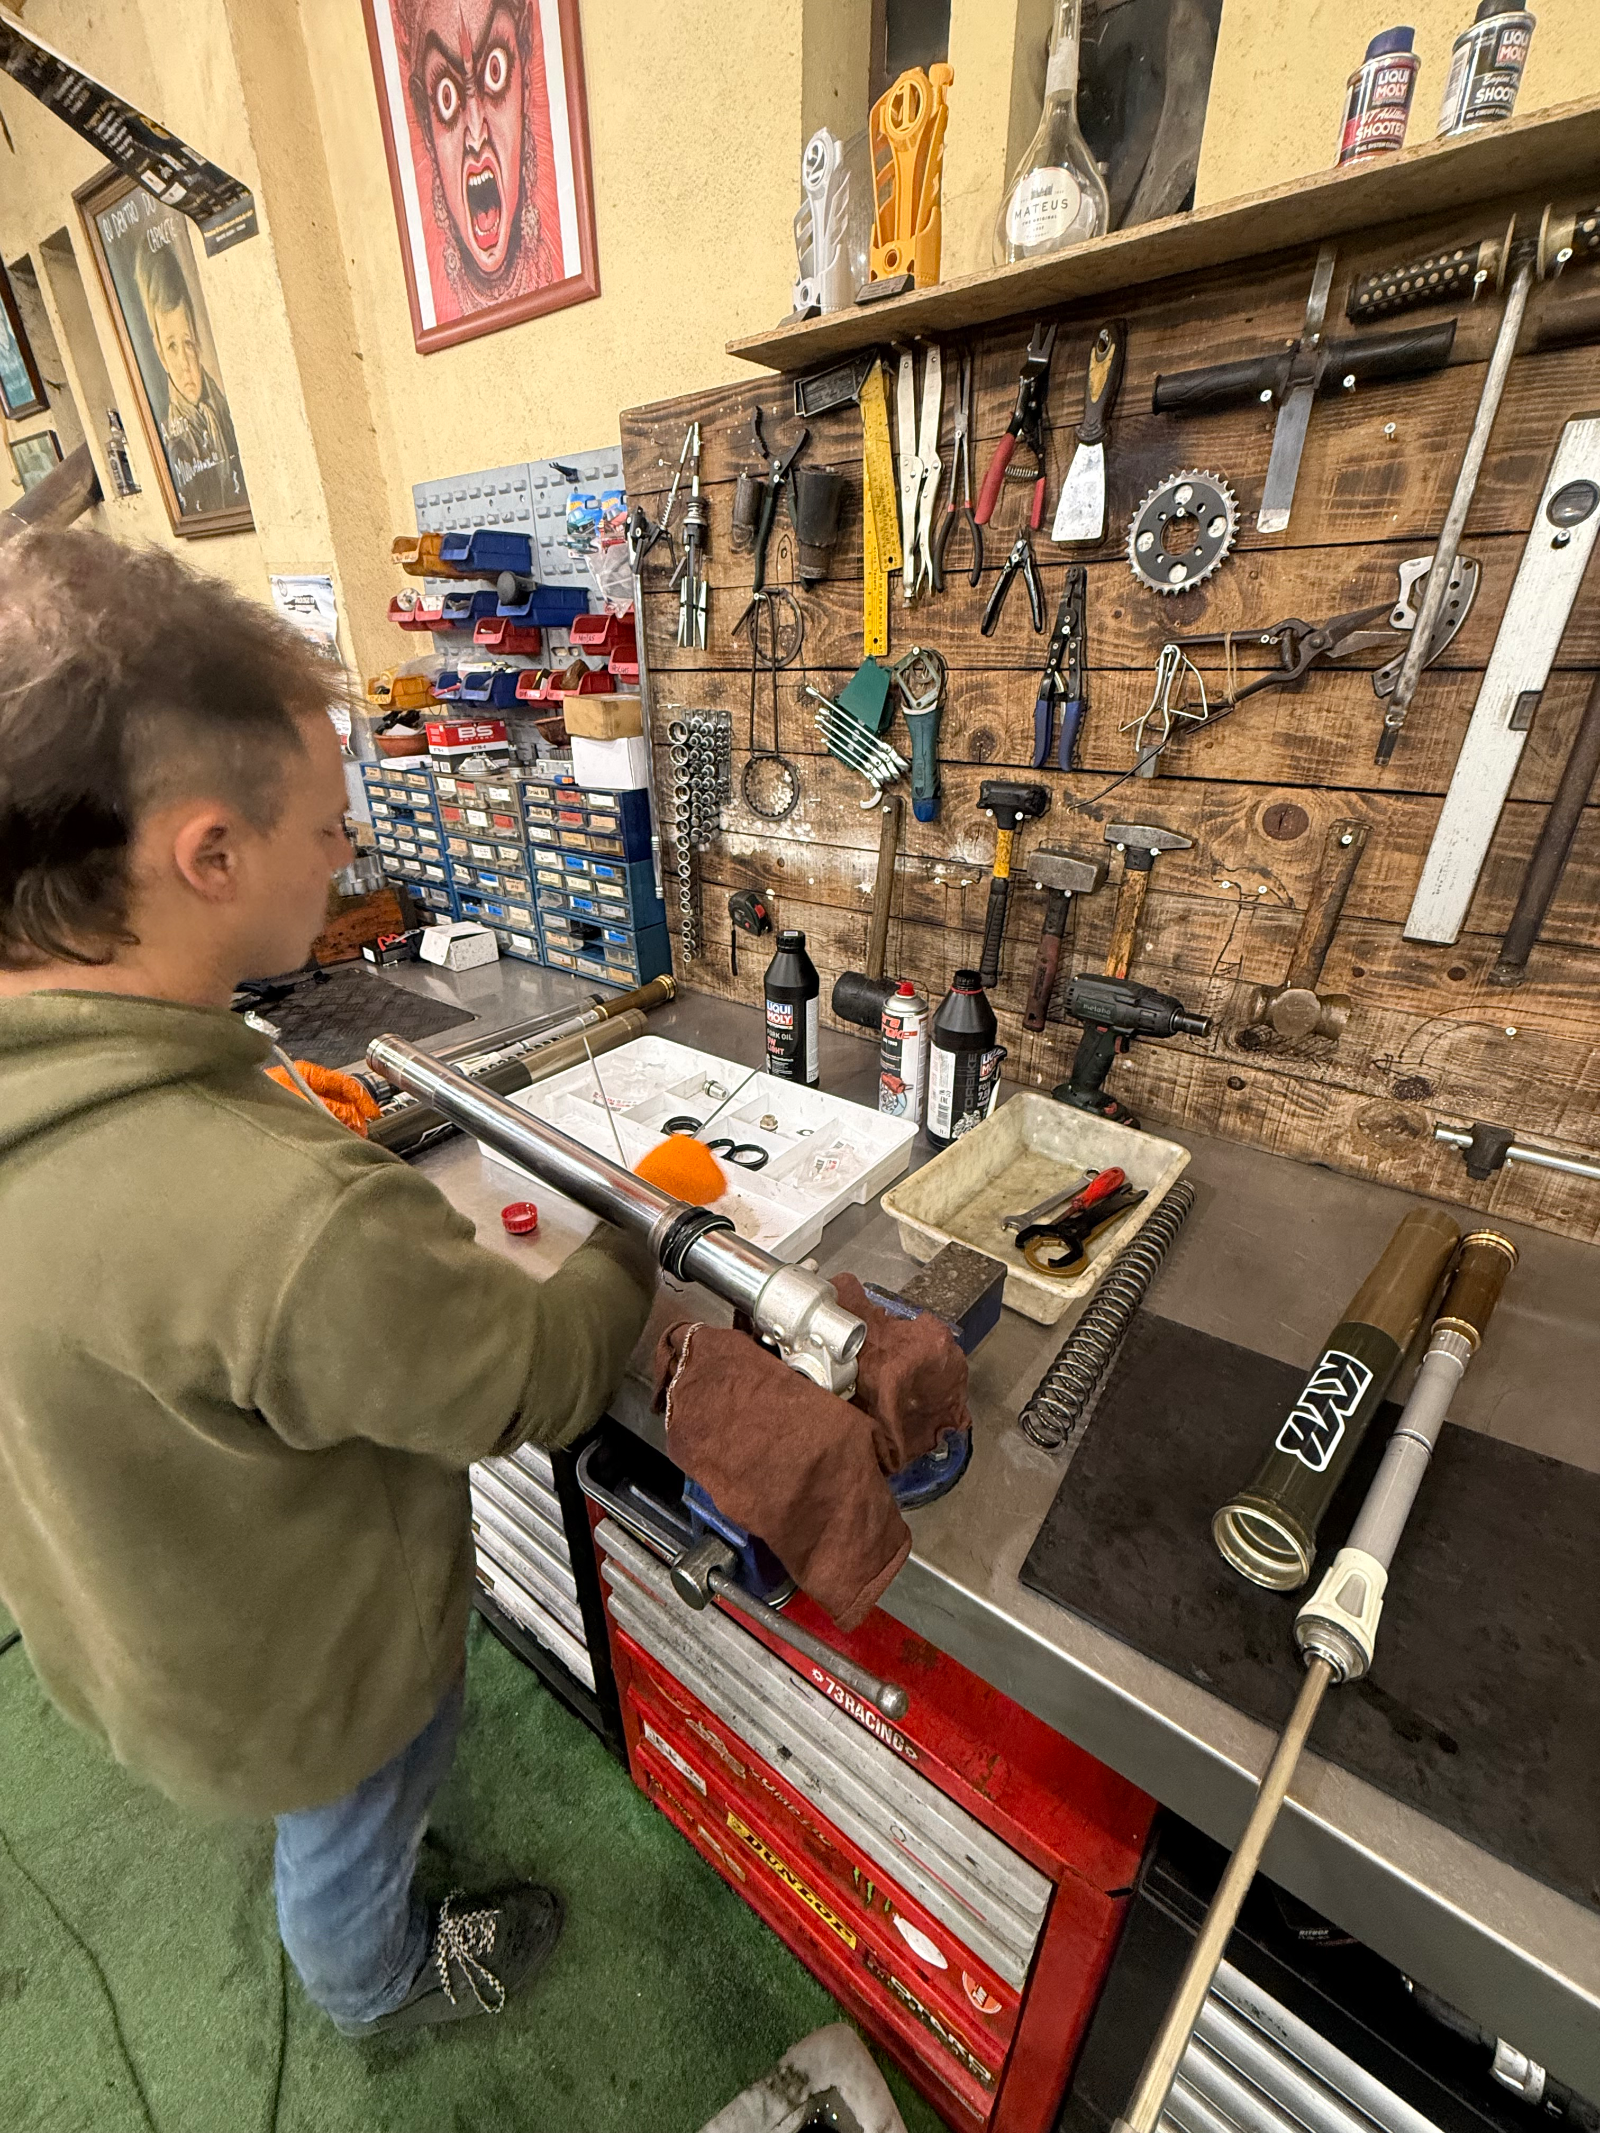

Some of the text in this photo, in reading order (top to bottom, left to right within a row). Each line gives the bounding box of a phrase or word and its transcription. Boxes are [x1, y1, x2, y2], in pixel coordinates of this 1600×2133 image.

[1377, 69, 1410, 85] LIQUI
[1375, 84, 1409, 99] MOLY
[1474, 85, 1515, 104] SHOOT
[1354, 121, 1406, 142] SHOOTER
[1014, 198, 1068, 220] MATEUS
[457, 724, 495, 739] BS
[767, 1009, 793, 1025] MOLY
[1082, 1003, 1112, 1015] metabo
[781, 1032, 794, 1041] OIL
[964, 1052, 978, 1113] TORBIKE
[1275, 1350, 1373, 1472] KYB
[743, 1833, 853, 1939] DUNLOP
